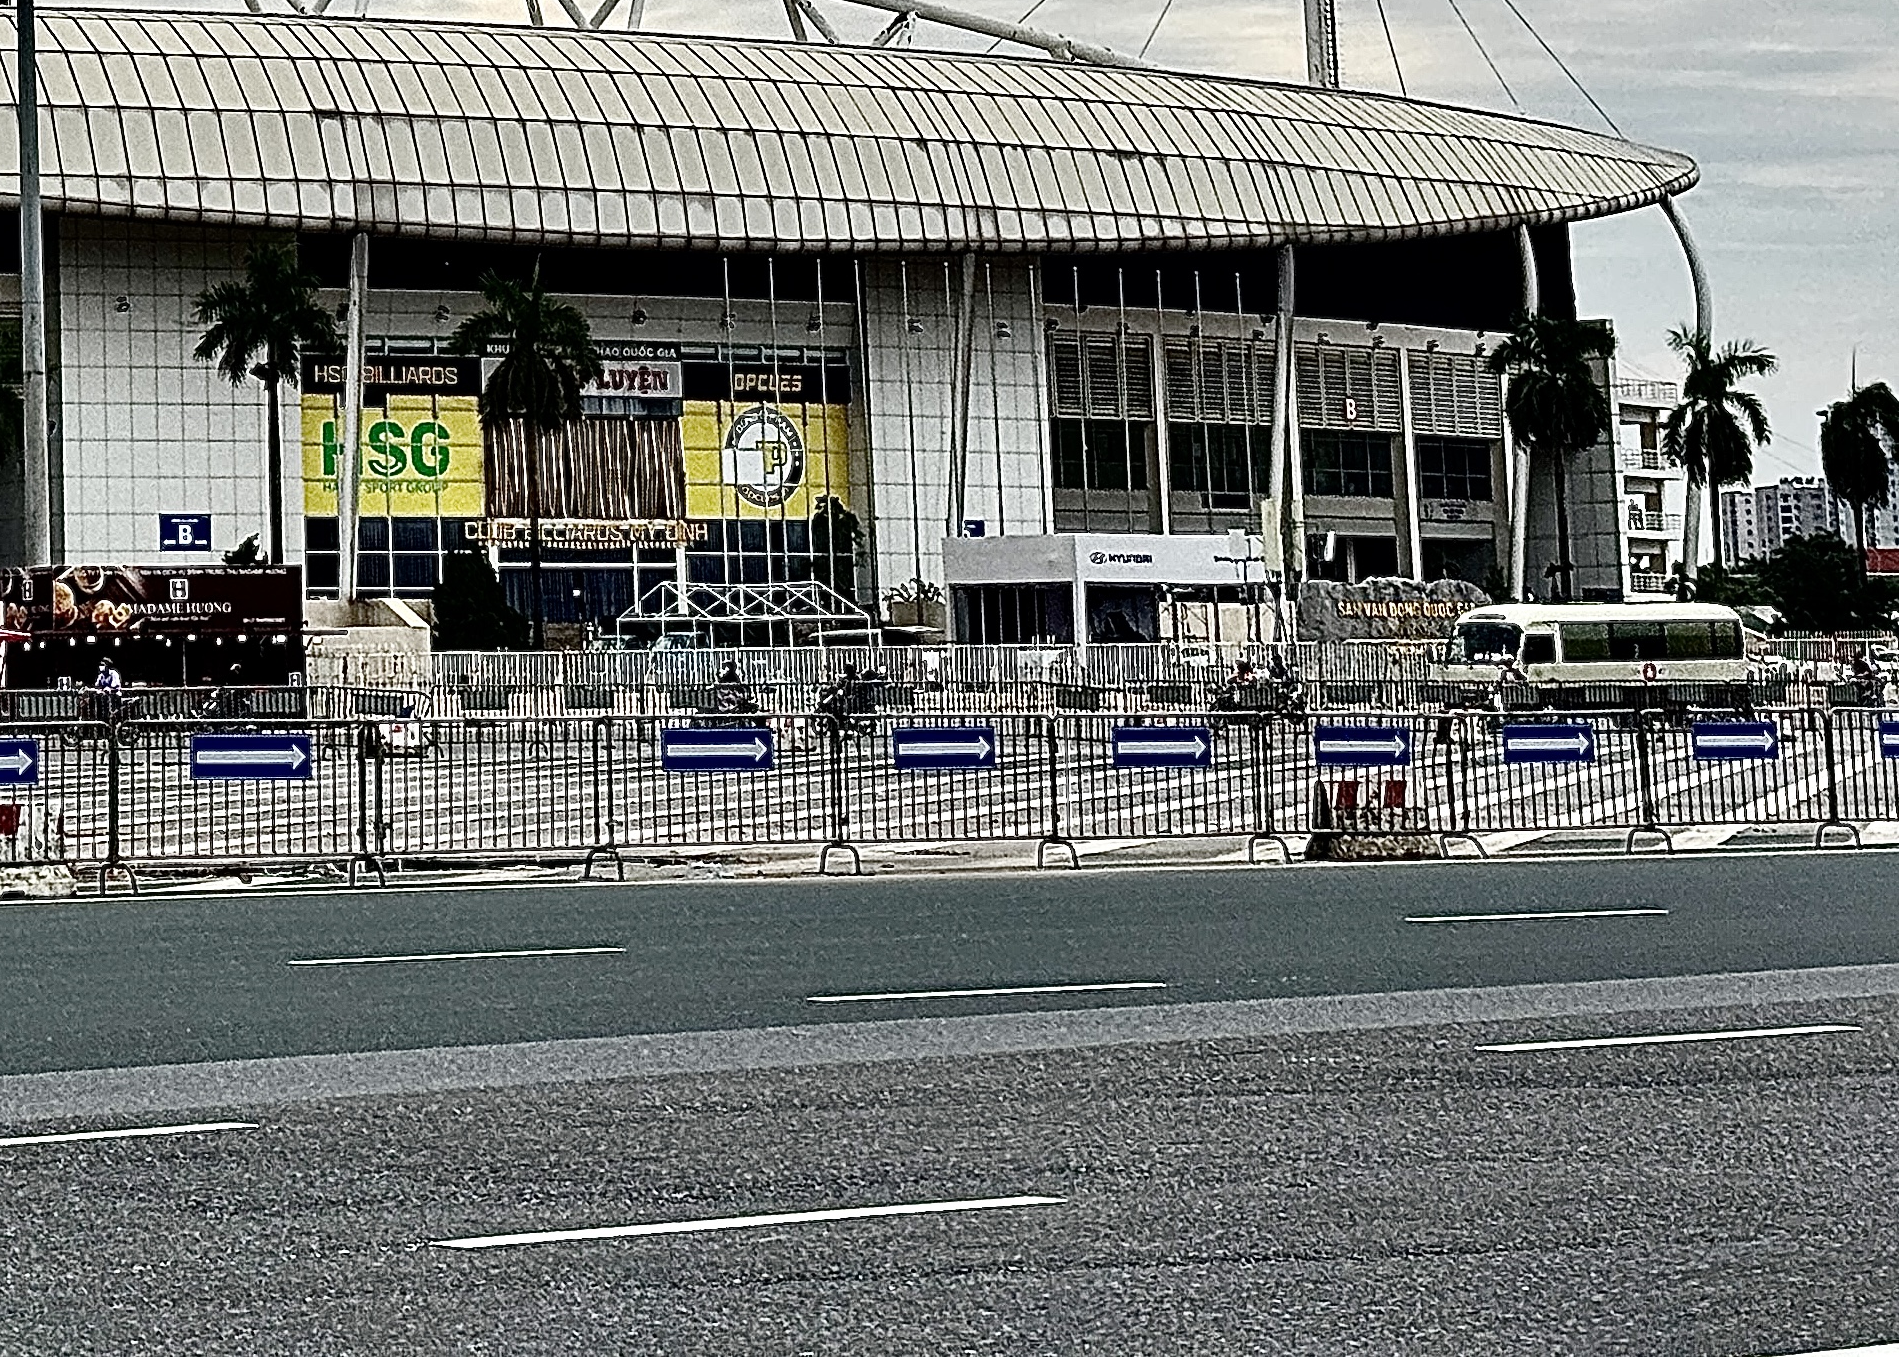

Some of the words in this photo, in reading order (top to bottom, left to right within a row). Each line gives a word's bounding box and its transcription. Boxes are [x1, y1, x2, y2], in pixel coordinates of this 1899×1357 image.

[657, 348, 677, 359] GIA
[361, 365, 459, 385] BILLIARDS
[597, 365, 669, 395] LUYỆN
[1345, 398, 1358, 420] B
[365, 481, 403, 493] SPORT
[406, 481, 448, 493] GROUP
[178, 524, 193, 545] B
[1108, 553, 1153, 564] HYUNDAI
[128, 603, 184, 614] MADAME
